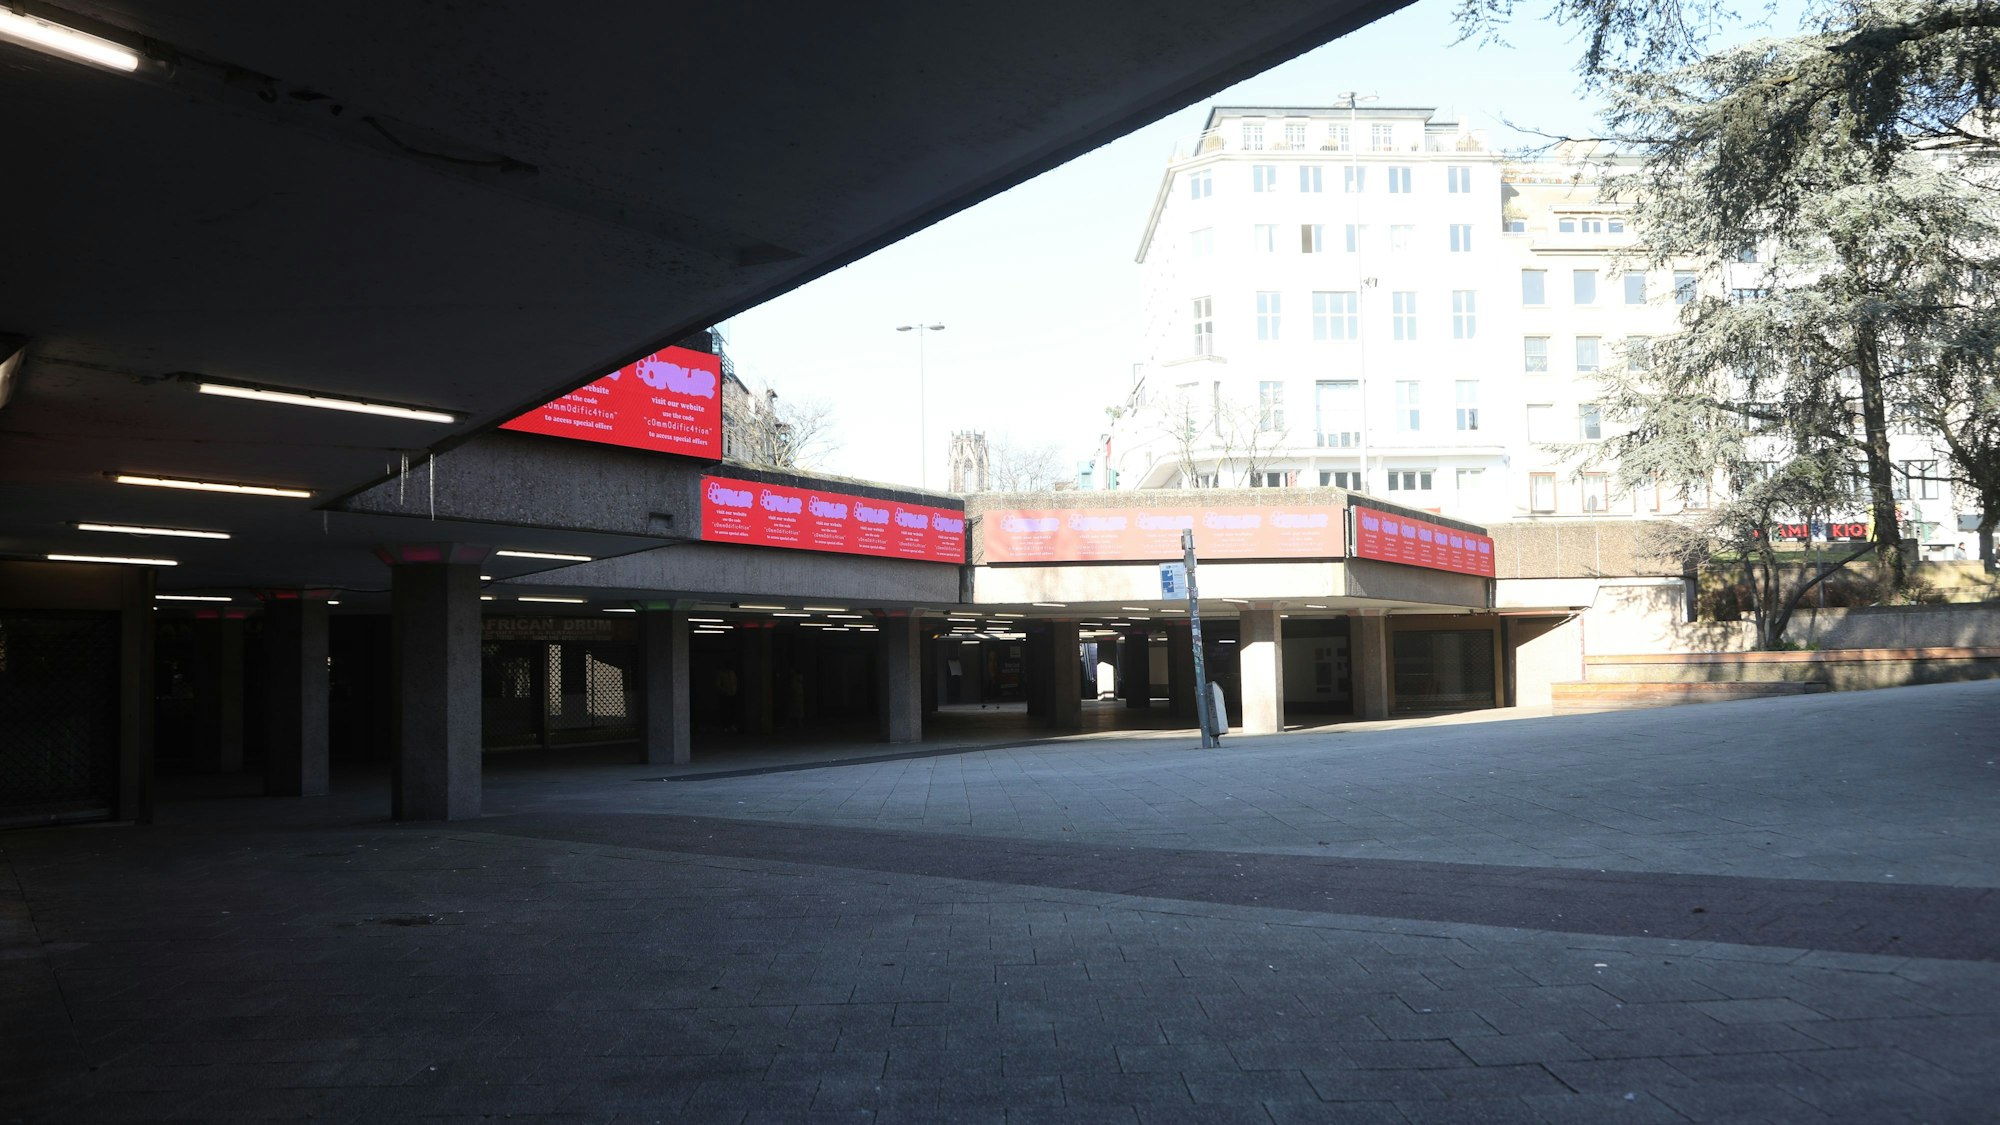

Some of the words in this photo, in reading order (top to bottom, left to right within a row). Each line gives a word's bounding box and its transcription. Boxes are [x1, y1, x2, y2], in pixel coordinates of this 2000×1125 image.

[584, 397, 598, 405] code
[651, 396, 667, 406] visit
[667, 400, 680, 408] our
[680, 401, 705, 412] website
[672, 412, 682, 420] the
[553, 416, 572, 424] access
[573, 419, 594, 428] special
[595, 422, 613, 431] offers
[673, 435, 692, 444] special
[692, 438, 708, 446] offers
[564, 618, 612, 631] DRUM
